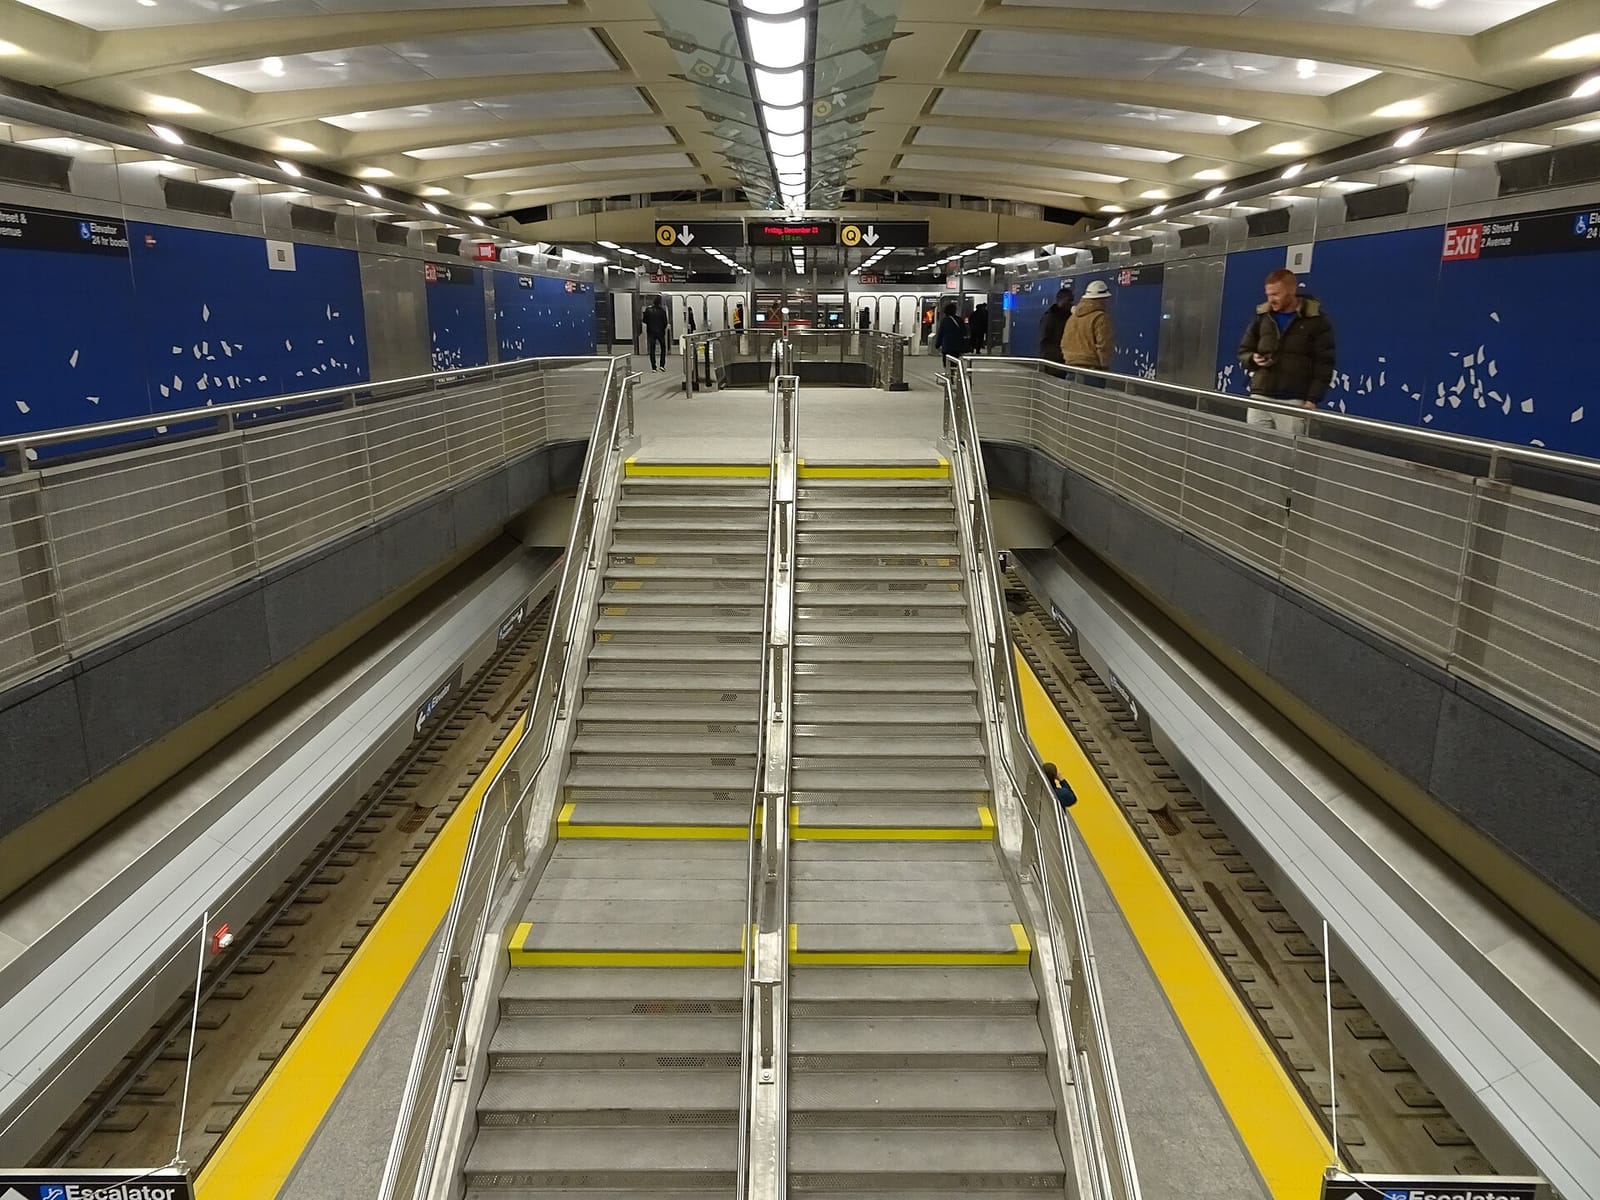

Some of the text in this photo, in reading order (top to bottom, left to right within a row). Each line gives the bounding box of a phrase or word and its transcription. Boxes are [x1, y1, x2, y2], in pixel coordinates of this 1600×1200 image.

[20, 213, 27, 224] &
[90, 222, 117, 234] Elevator
[1481, 221, 1519, 235] 96 Street &
[1586, 227, 1597, 239] 24
[92, 235, 100, 245] 24
[101, 236, 109, 246] hr
[1443, 228, 1479, 256] Exit
[1480, 237, 1512, 248] 2 Avenue
[650, 273, 668, 283] Exit
[860, 274, 878, 284] Exit
[65, 1184, 175, 1200] Escalator
